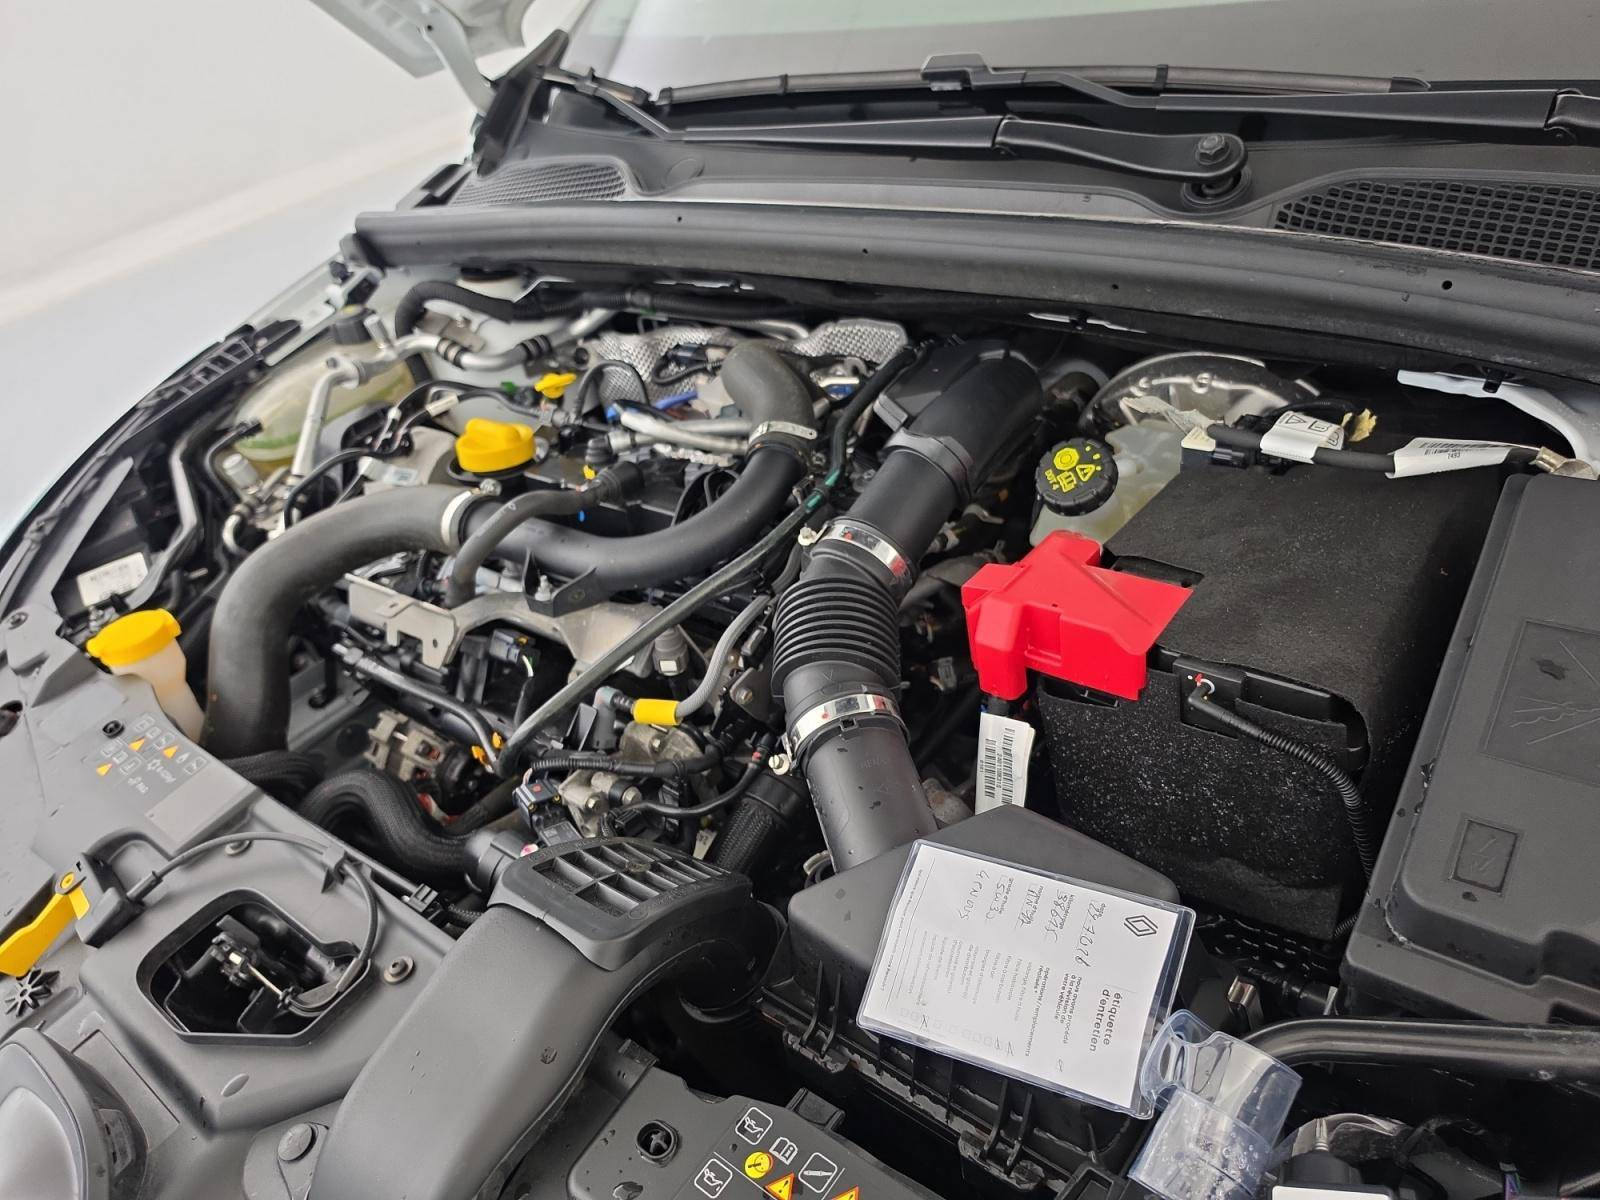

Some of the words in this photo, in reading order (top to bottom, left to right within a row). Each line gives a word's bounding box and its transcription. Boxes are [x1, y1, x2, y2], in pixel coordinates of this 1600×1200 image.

[1068, 992, 1078, 1014] avons
[1074, 976, 1082, 993] nous
[1089, 988, 1111, 1052] d'entretien
[1102, 992, 1123, 1045] étiquette
